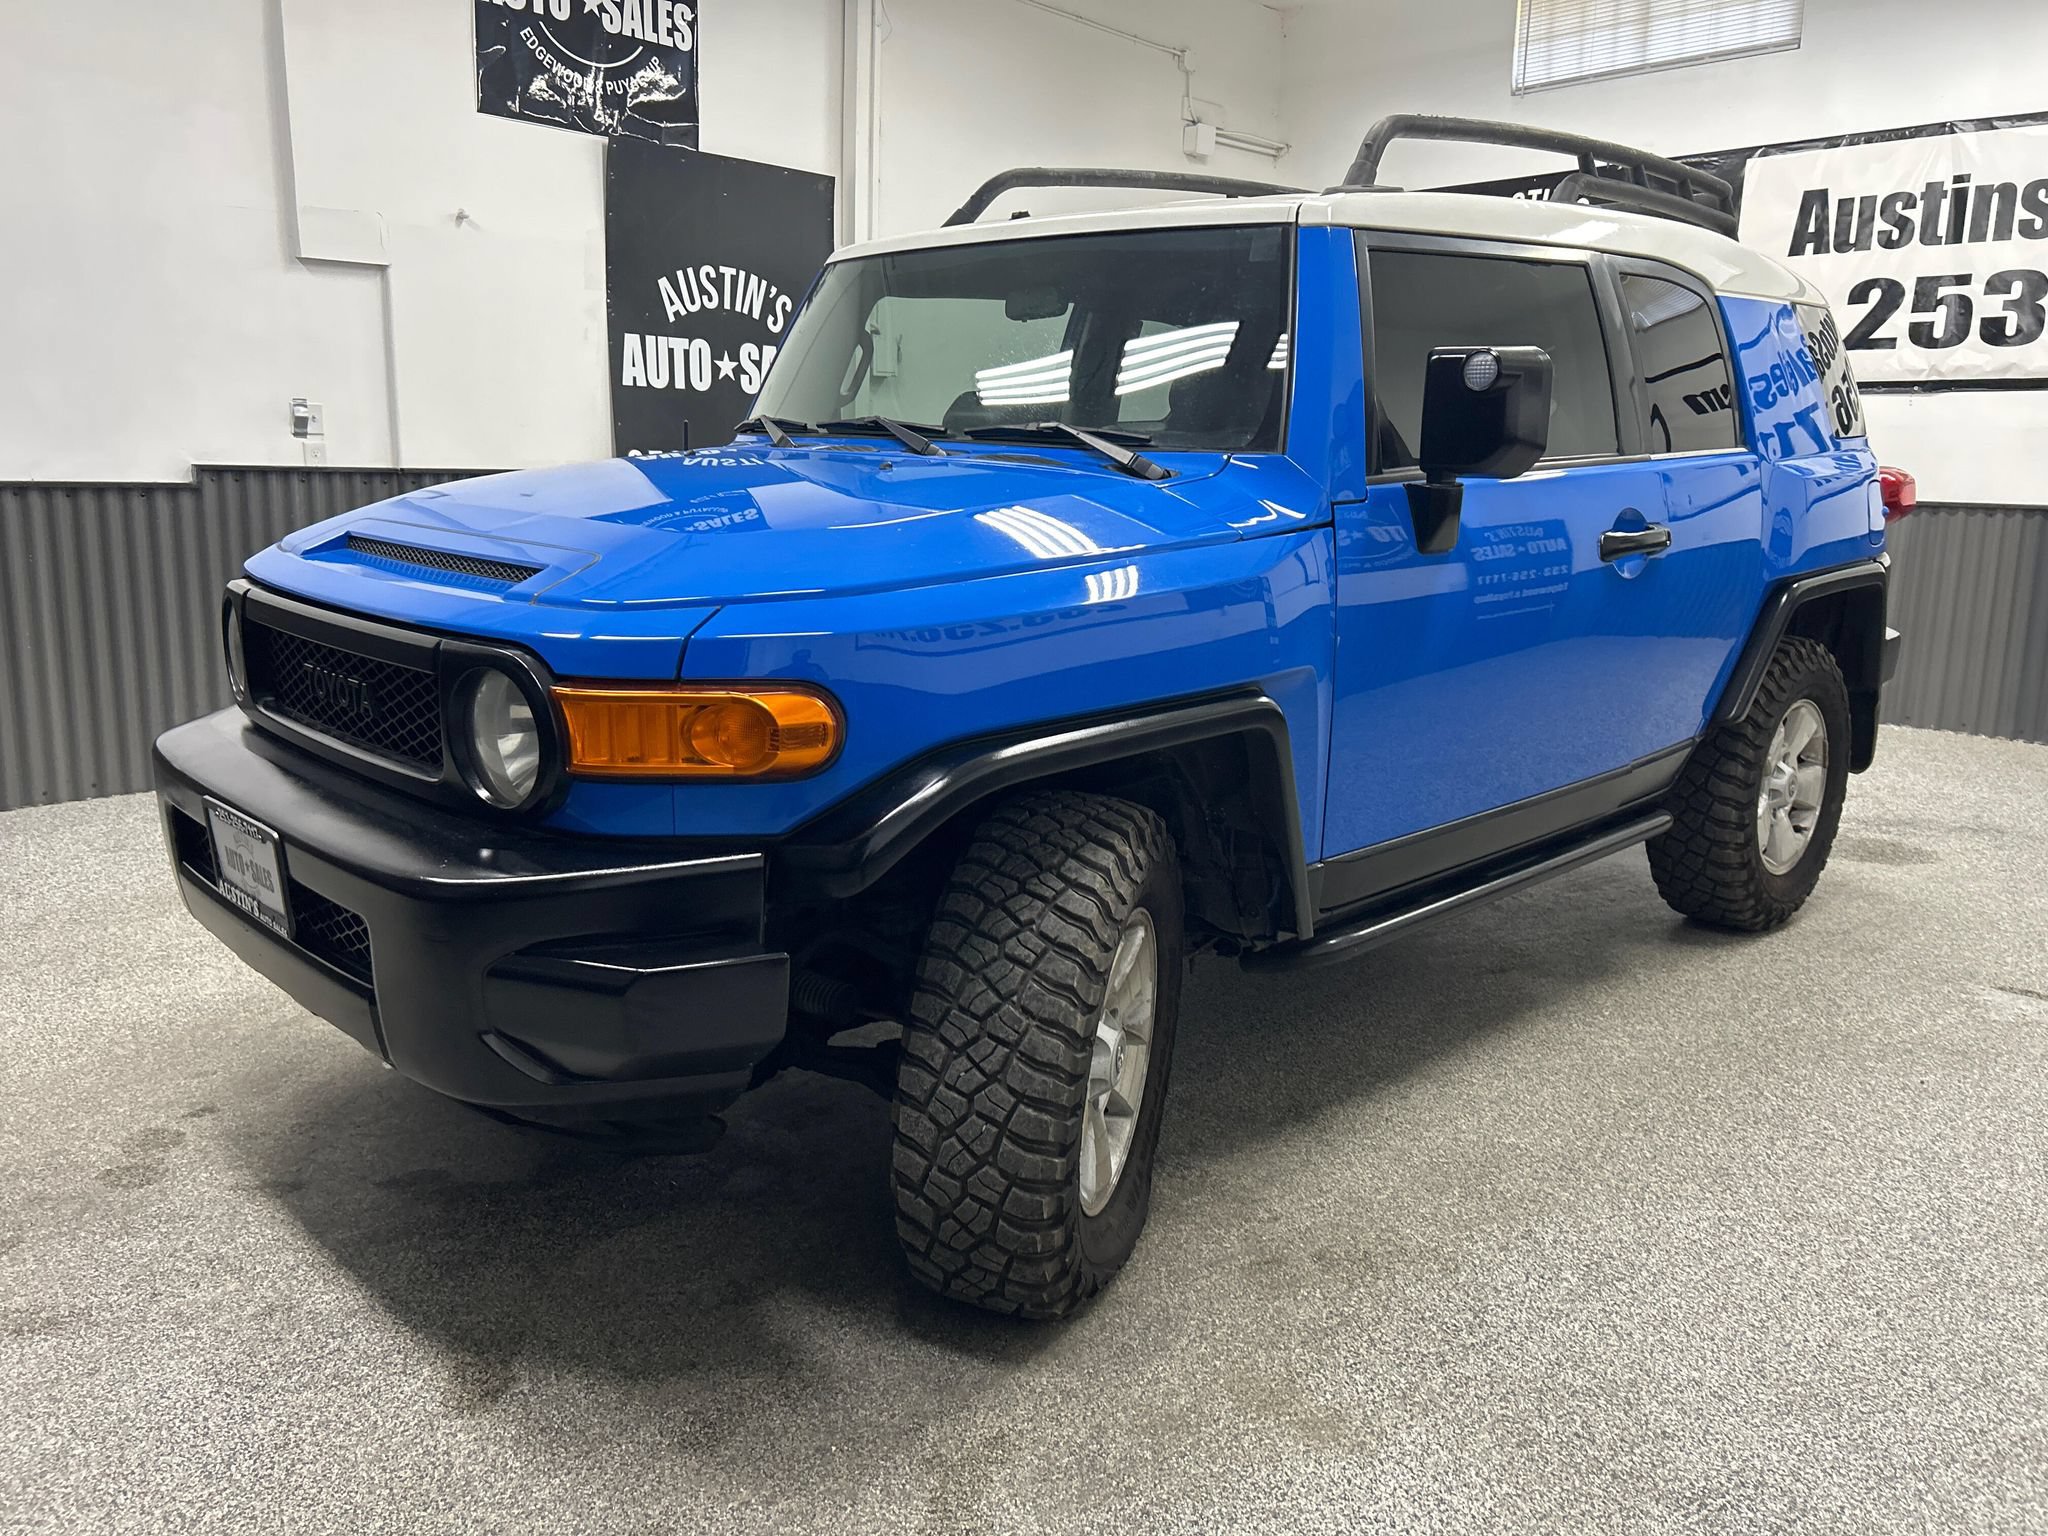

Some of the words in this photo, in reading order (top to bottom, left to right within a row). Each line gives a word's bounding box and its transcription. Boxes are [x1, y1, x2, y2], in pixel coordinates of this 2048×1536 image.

[601, 0, 692, 51] SALES
[606, 56, 662, 96] PUYAUP
[657, 264, 792, 333] AUSTIN'S
[1845, 269, 2047, 351] 253
[622, 333, 712, 391] AUTO
[249, 859, 275, 894] SALES
